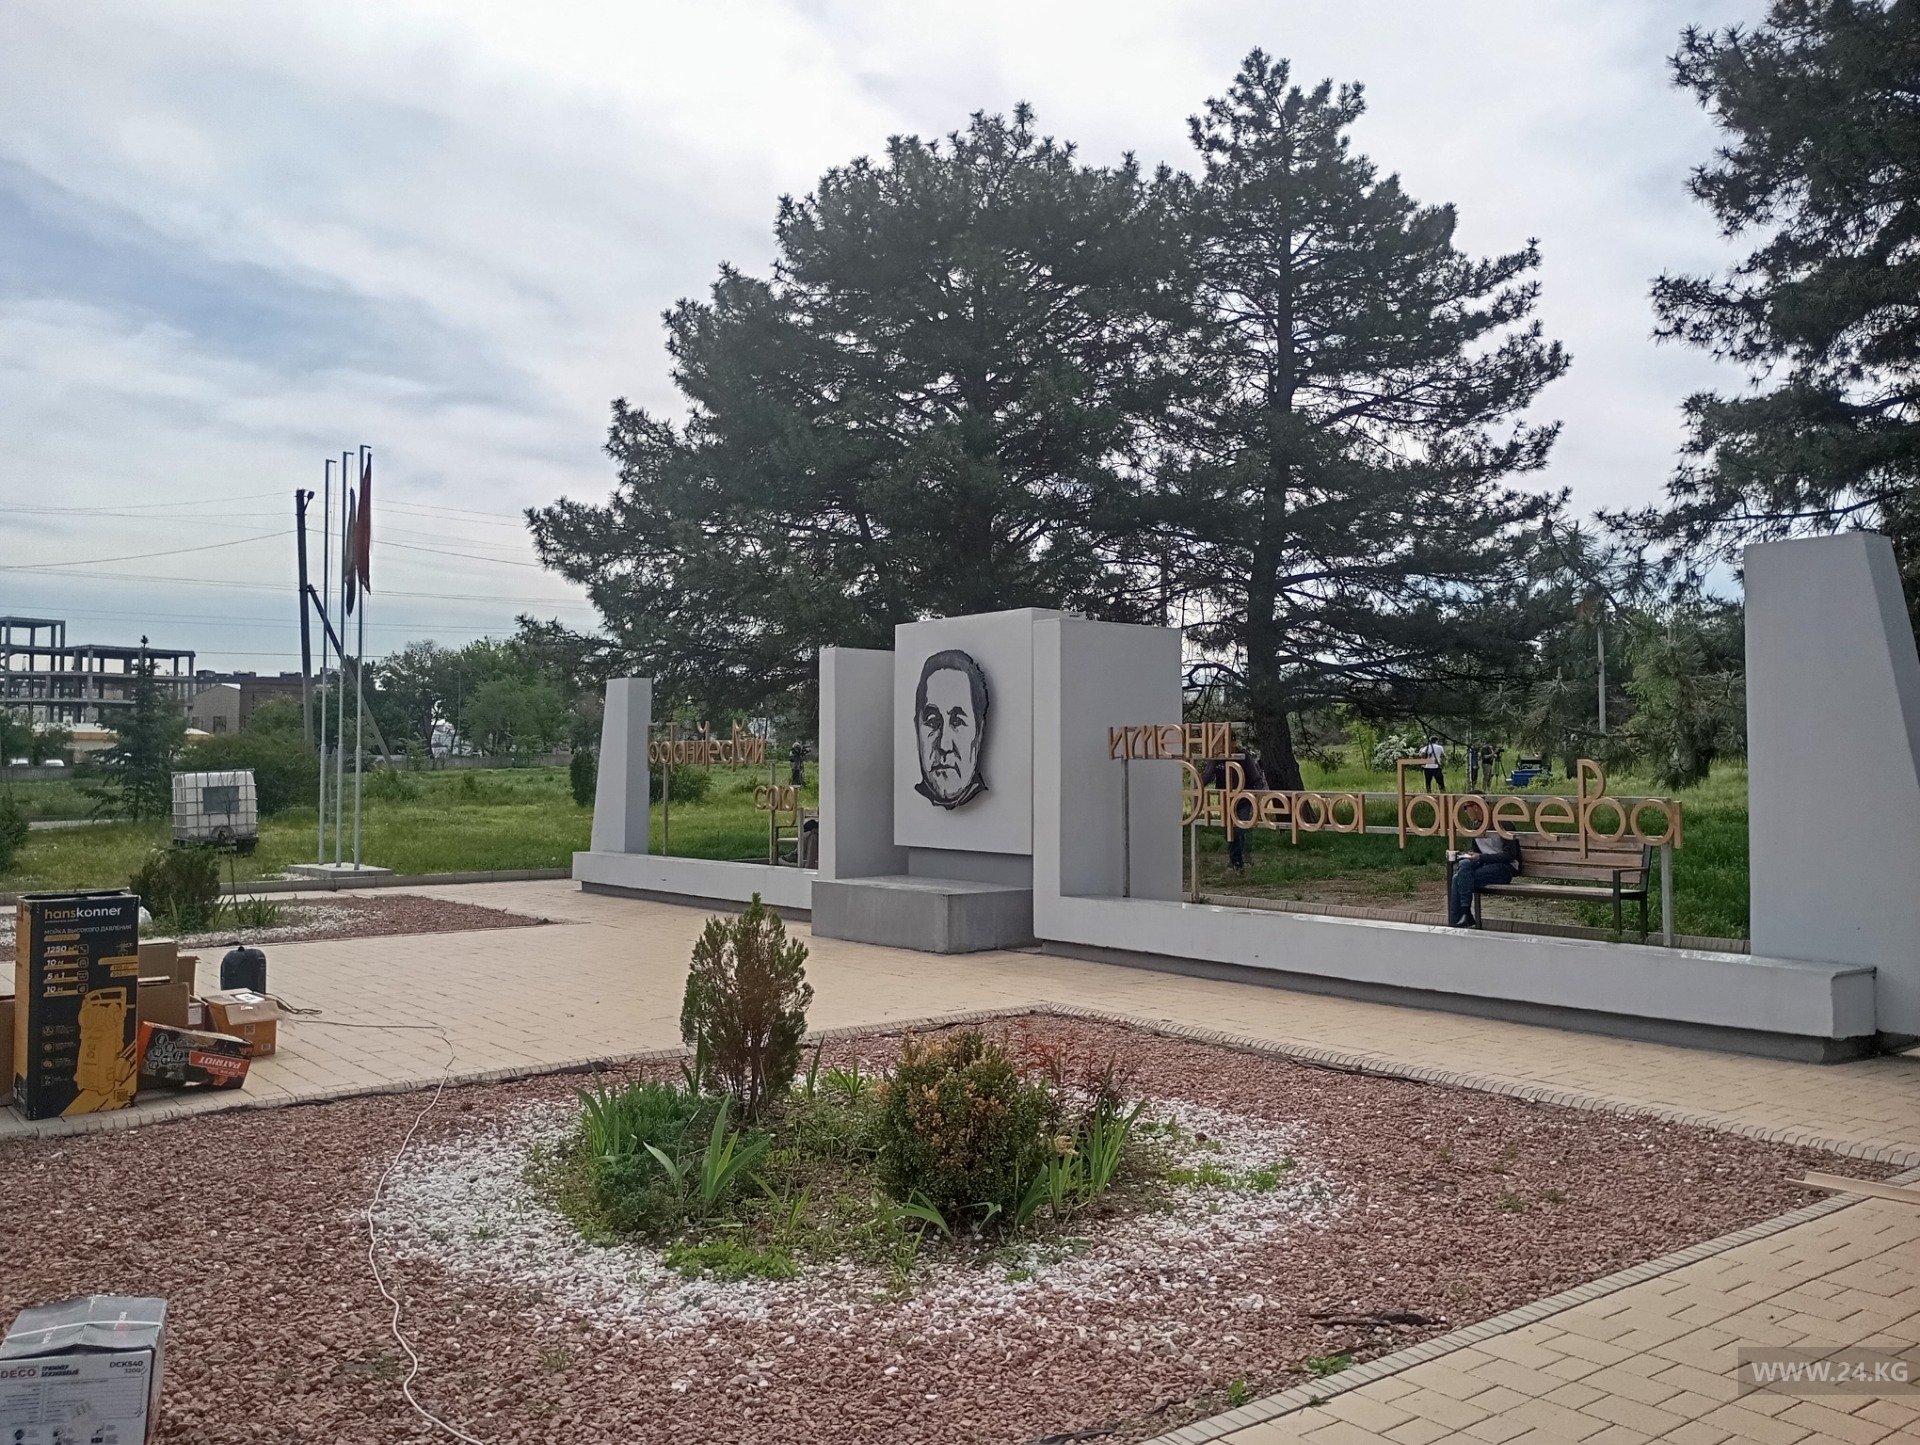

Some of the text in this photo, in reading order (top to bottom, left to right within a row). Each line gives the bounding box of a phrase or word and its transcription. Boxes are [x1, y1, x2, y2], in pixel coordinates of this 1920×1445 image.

[1108, 721, 1231, 760] имени
[44, 907, 122, 920] hanskonner
[199, 1056, 242, 1069] PATRIOT
[0, 1368, 37, 1379] DECO
